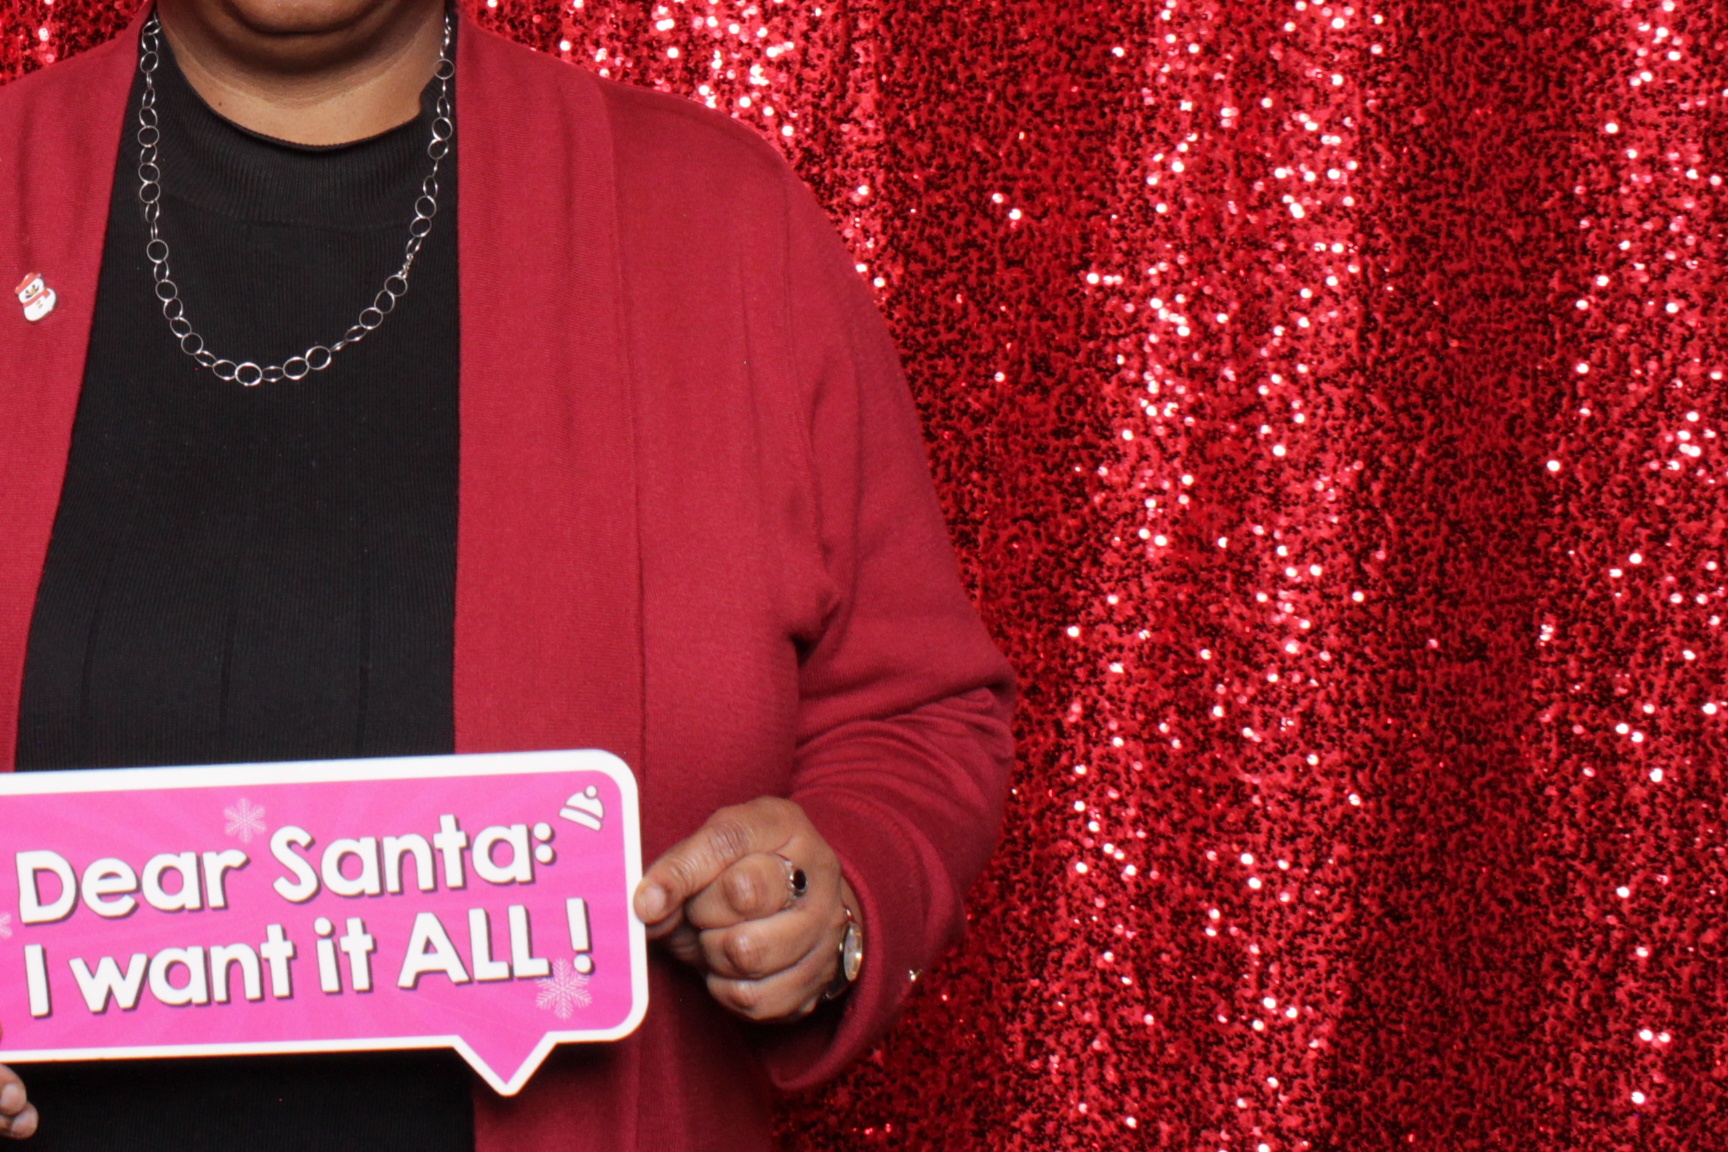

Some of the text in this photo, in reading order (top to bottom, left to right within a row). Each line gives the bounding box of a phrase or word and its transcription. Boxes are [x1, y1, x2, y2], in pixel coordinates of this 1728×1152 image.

[15, 848, 249, 924] Dear
[269, 813, 556, 904] Santa:
[23, 944, 52, 1019] I
[68, 923, 294, 1015] want
[313, 917, 375, 995] it
